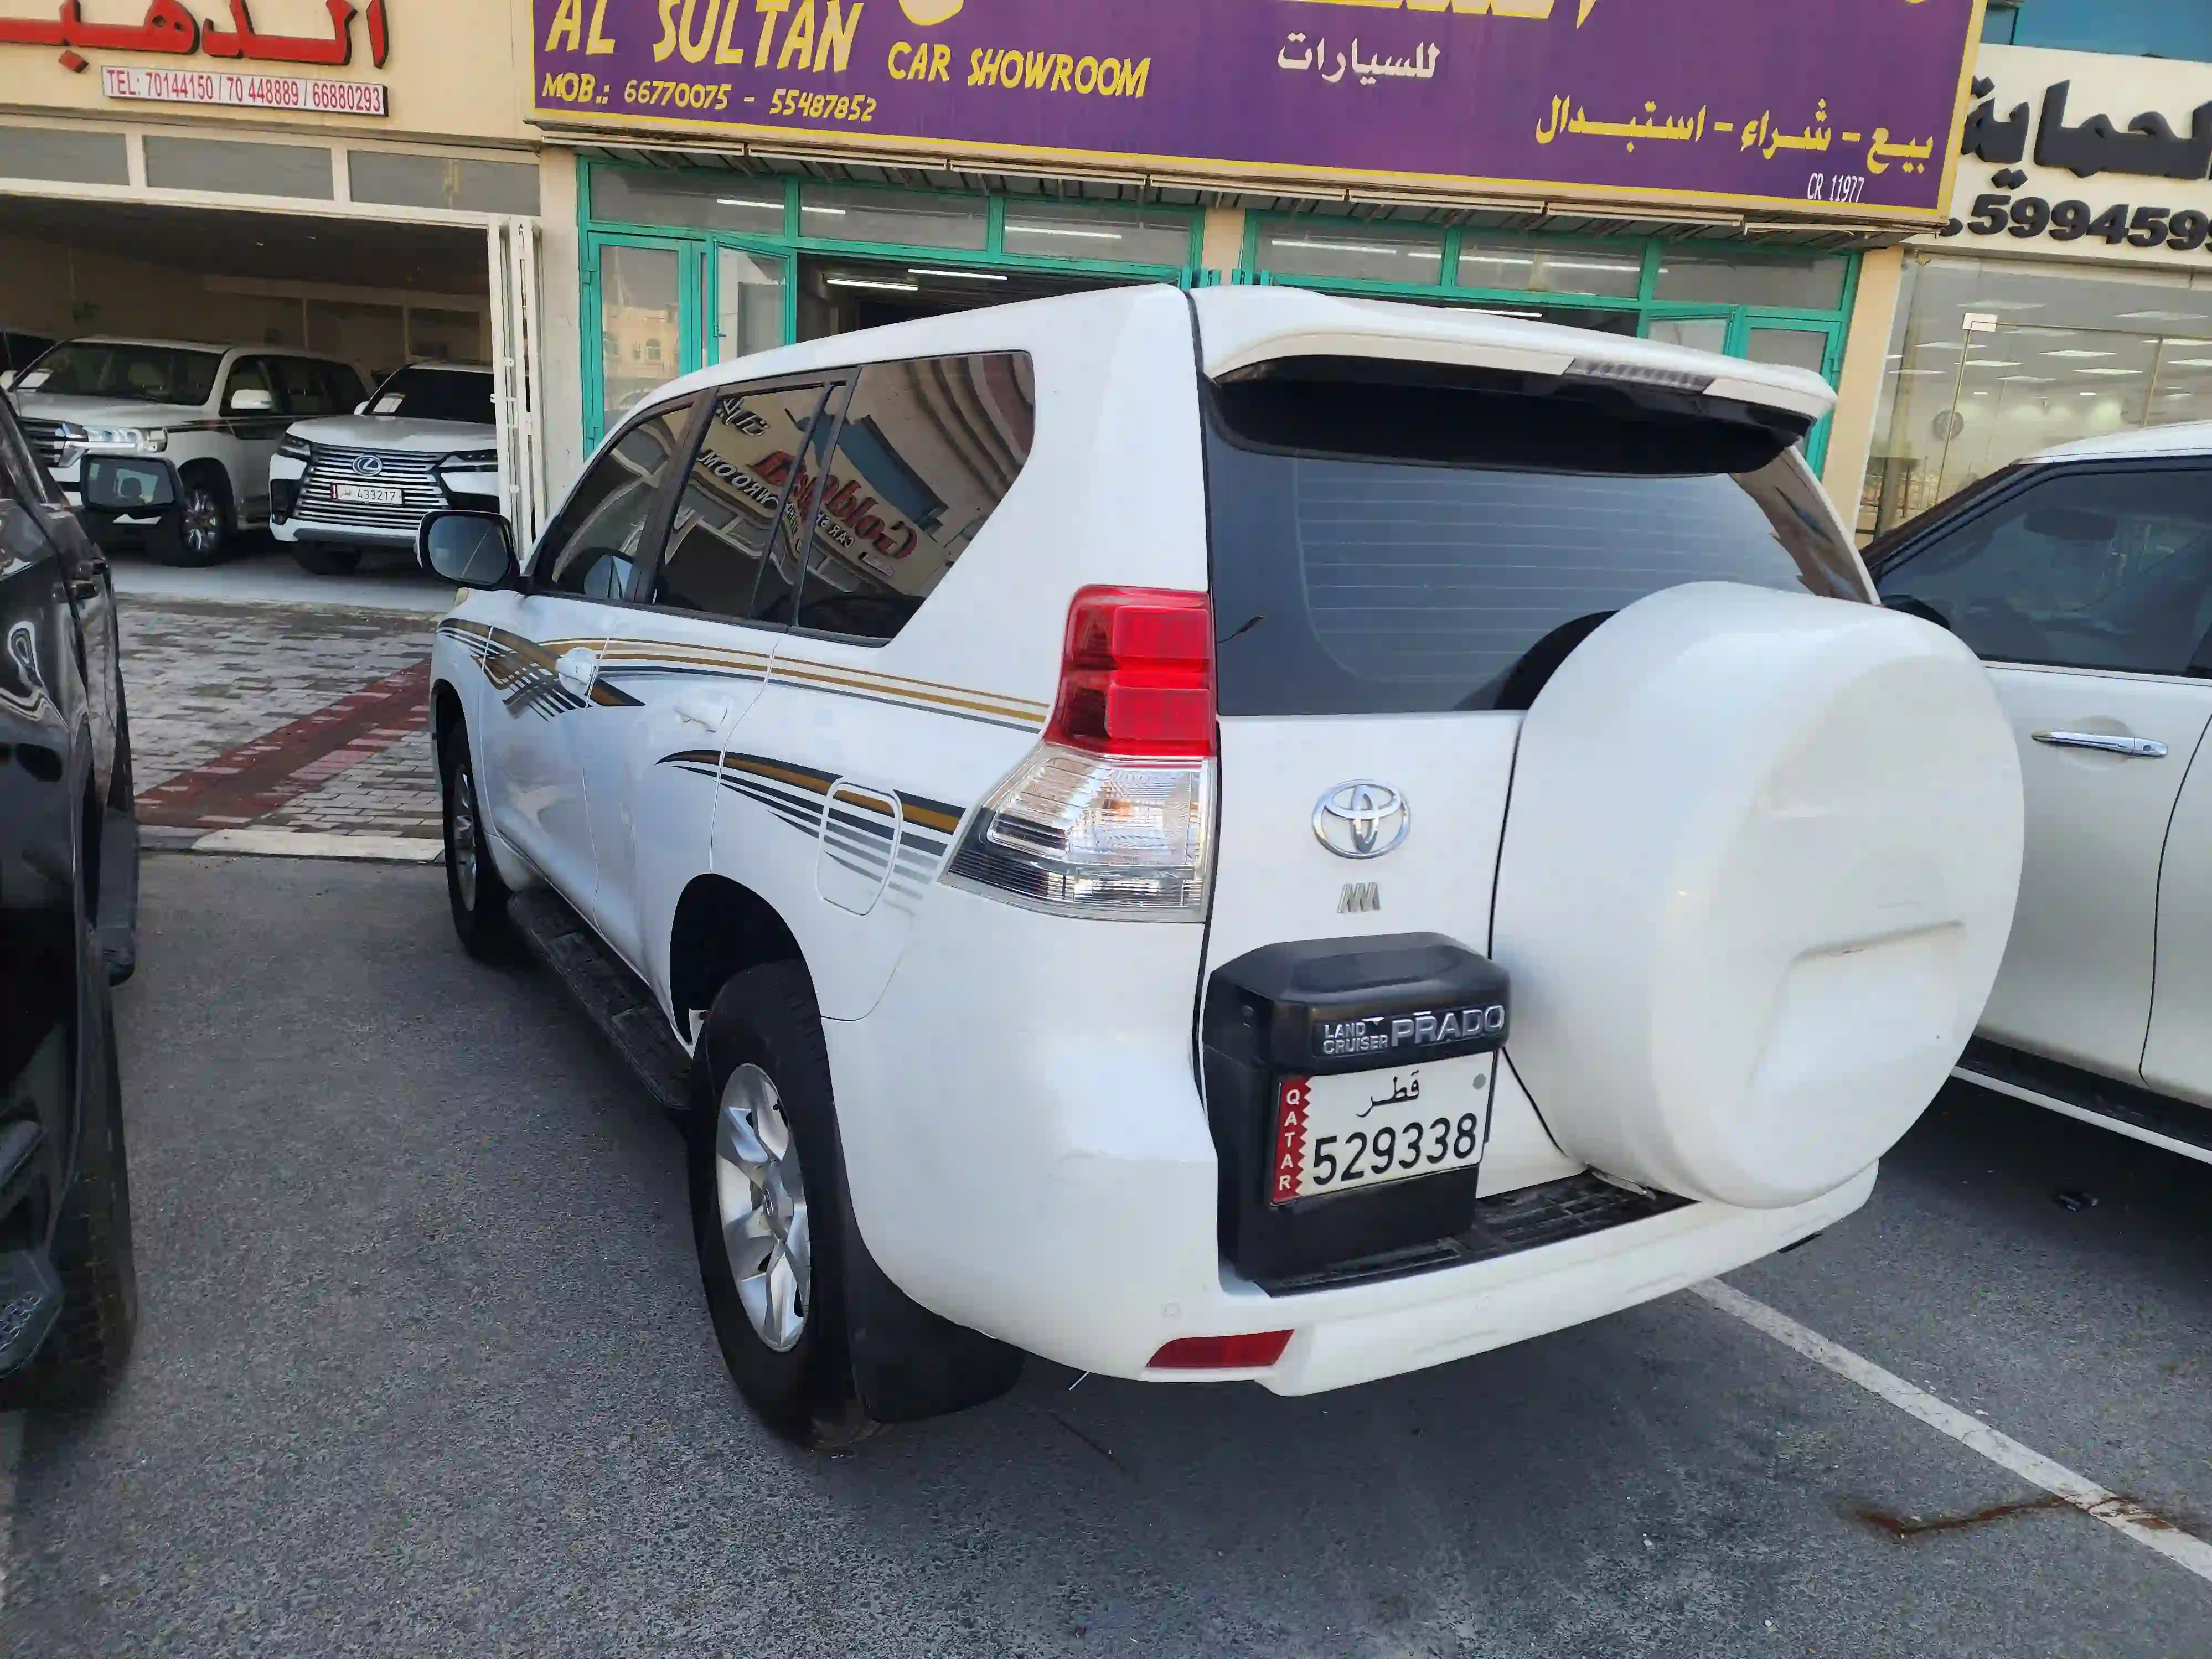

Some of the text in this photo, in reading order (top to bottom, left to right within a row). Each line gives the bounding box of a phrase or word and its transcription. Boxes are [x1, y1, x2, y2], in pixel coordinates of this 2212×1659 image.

[545, 0, 864, 73] AL SULTAN
[1278, 32, 1440, 85] للسيارات
[107, 69, 141, 96] TEL:
[145, 72, 214, 100] 70144150
[312, 82, 381, 112] 66880293
[888, 42, 1151, 98] CAR SHOWROOM
[542, 72, 610, 104] MOB.:
[625, 79, 732, 110] 66770075
[769, 88, 876, 122] 55487852
[1536, 95, 1706, 153] استبدال
[1740, 99, 1832, 160] شراء
[1867, 127, 1934, 174] بيع
[1807, 172, 1865, 204] CR 11977
[356, 489, 396, 501] 433217
[1323, 1005, 1506, 1055] CRUISER PRADO
[1324, 1022, 1366, 1039] LAND
[1355, 1069, 1420, 1118] قطر
[1278, 1089, 1301, 1192] QATAR
[1312, 1112, 1479, 1186] 529338
